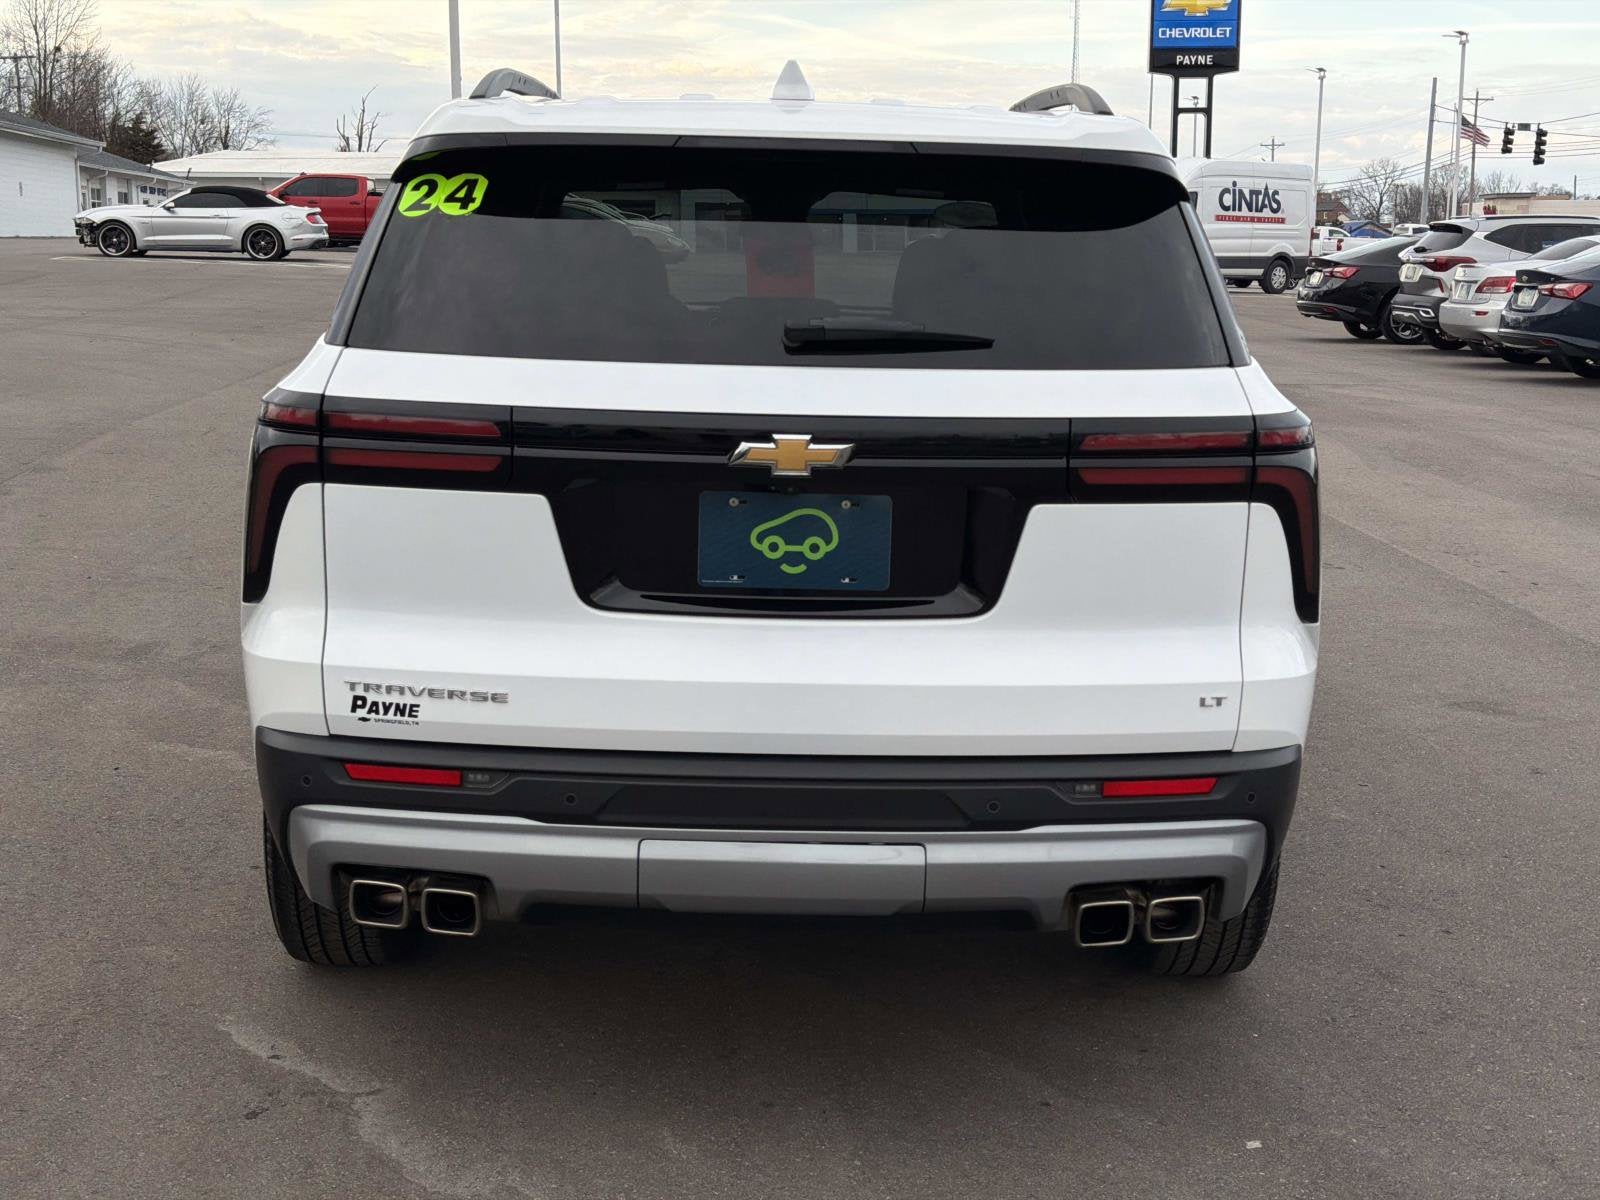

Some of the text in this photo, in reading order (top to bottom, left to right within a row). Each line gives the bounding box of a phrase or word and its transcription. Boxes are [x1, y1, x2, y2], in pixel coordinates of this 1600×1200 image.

[1158, 27, 1232, 39] CHEVROLET
[1176, 54, 1214, 66] PAYNE
[402, 178, 480, 213] 24
[344, 680, 509, 704] TRAVERSE
[350, 695, 421, 719] PAYNE
[1199, 696, 1228, 708] LT
